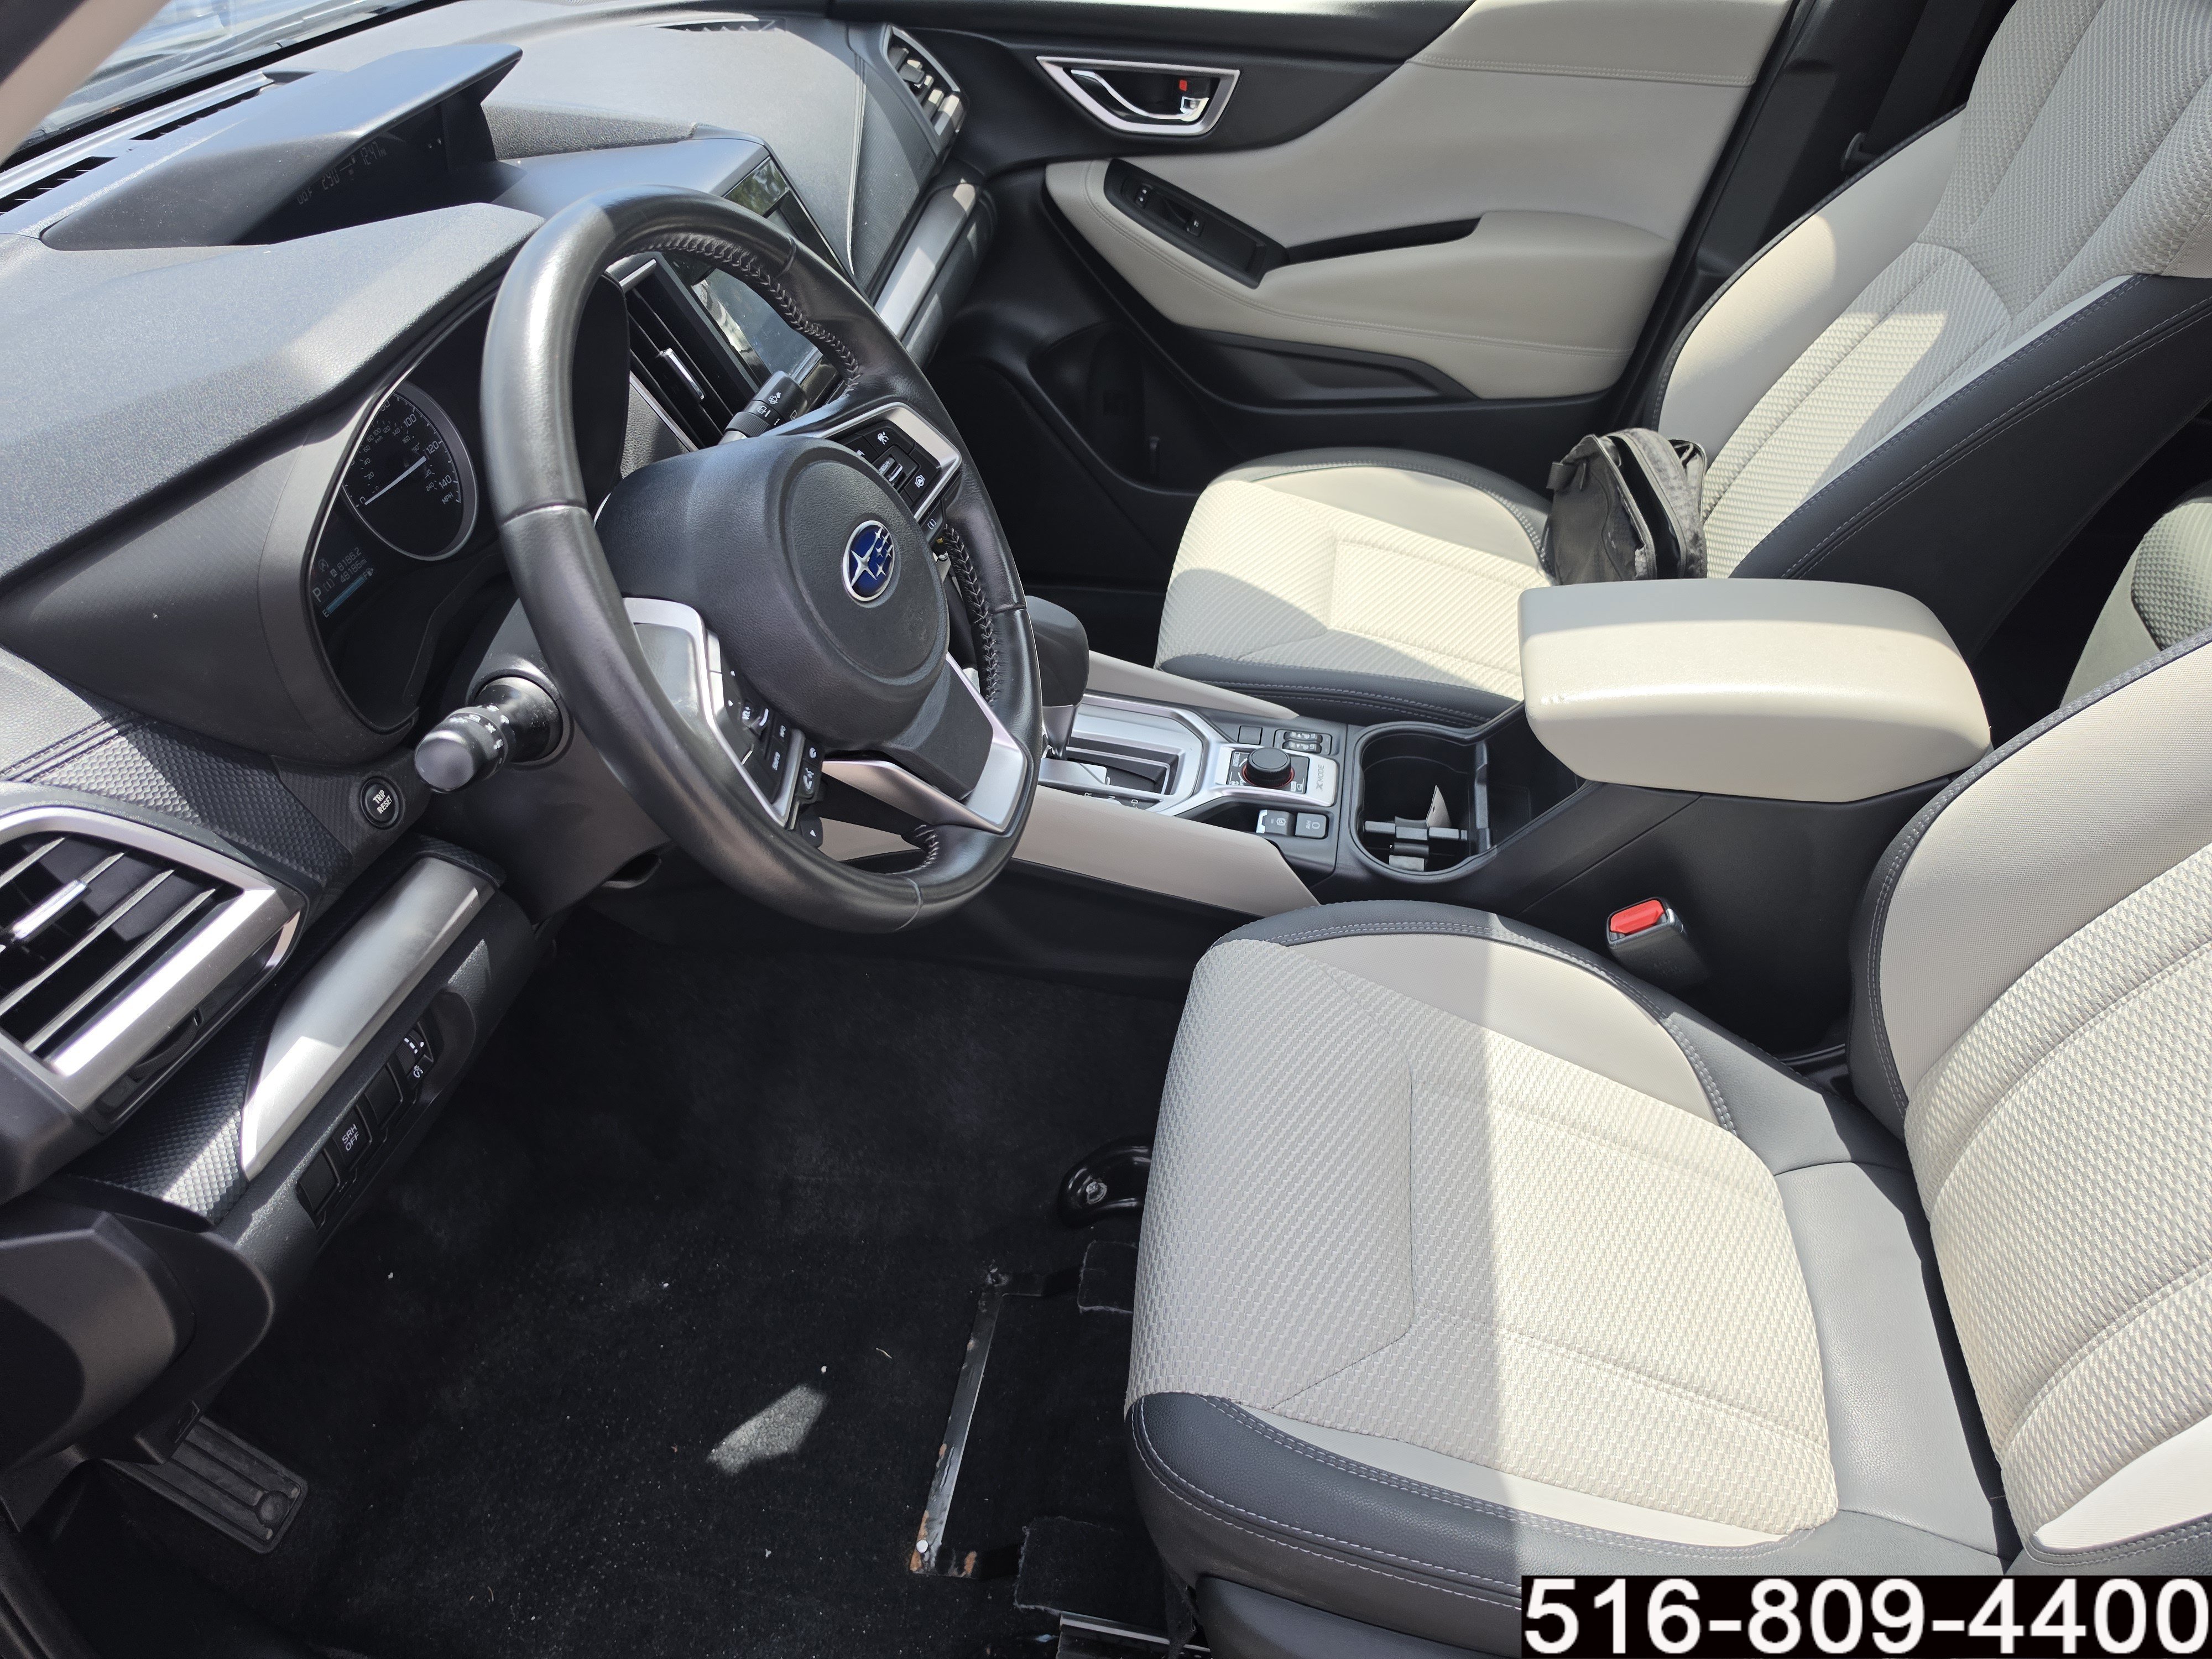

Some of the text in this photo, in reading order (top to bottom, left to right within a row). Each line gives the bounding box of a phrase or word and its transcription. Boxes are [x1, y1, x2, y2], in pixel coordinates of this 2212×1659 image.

[403, 414, 417, 427] 100
[426, 440, 439, 455] 120
[425, 482, 435, 492] 240
[439, 474, 452, 489] 140
[441, 492, 454, 505] MPH
[337, 547, 362, 571] 8186.2
[312, 587, 321, 603] P
[322, 609, 330, 618] E
[372, 789, 386, 804] TRIP
[377, 795, 393, 815] RESET
[342, 1123, 357, 1144] SRH
[345, 1131, 359, 1151] OFF
